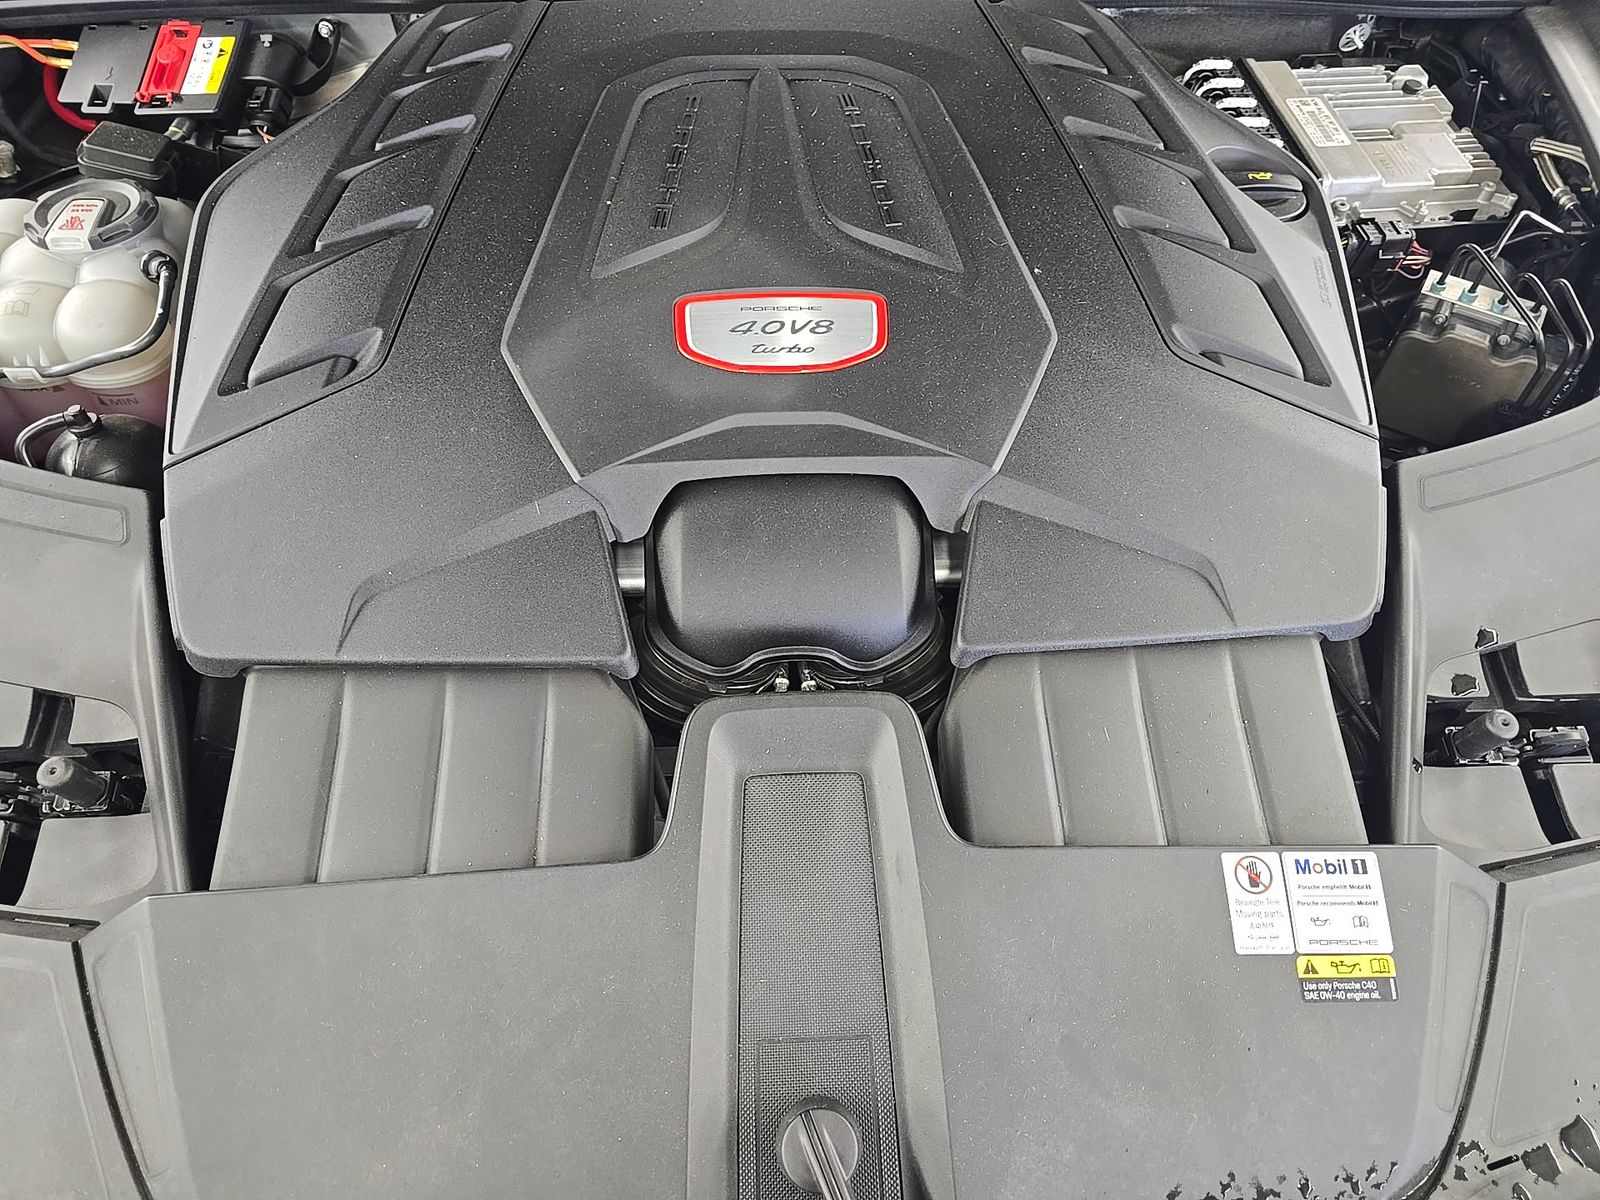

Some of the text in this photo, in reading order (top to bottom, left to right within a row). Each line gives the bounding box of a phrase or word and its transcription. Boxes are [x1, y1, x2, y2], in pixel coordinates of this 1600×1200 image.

[751, 343, 815, 354] turbo
[110, 398, 139, 406] MIN
[1294, 858, 1368, 875] Mobil 1
[1302, 981, 1317, 991] Use
[1318, 981, 1332, 992] only
[1333, 981, 1361, 990] Porsche
[1361, 980, 1378, 990] C40
[1304, 991, 1319, 1000] SAE
[1346, 990, 1370, 1002] engine
